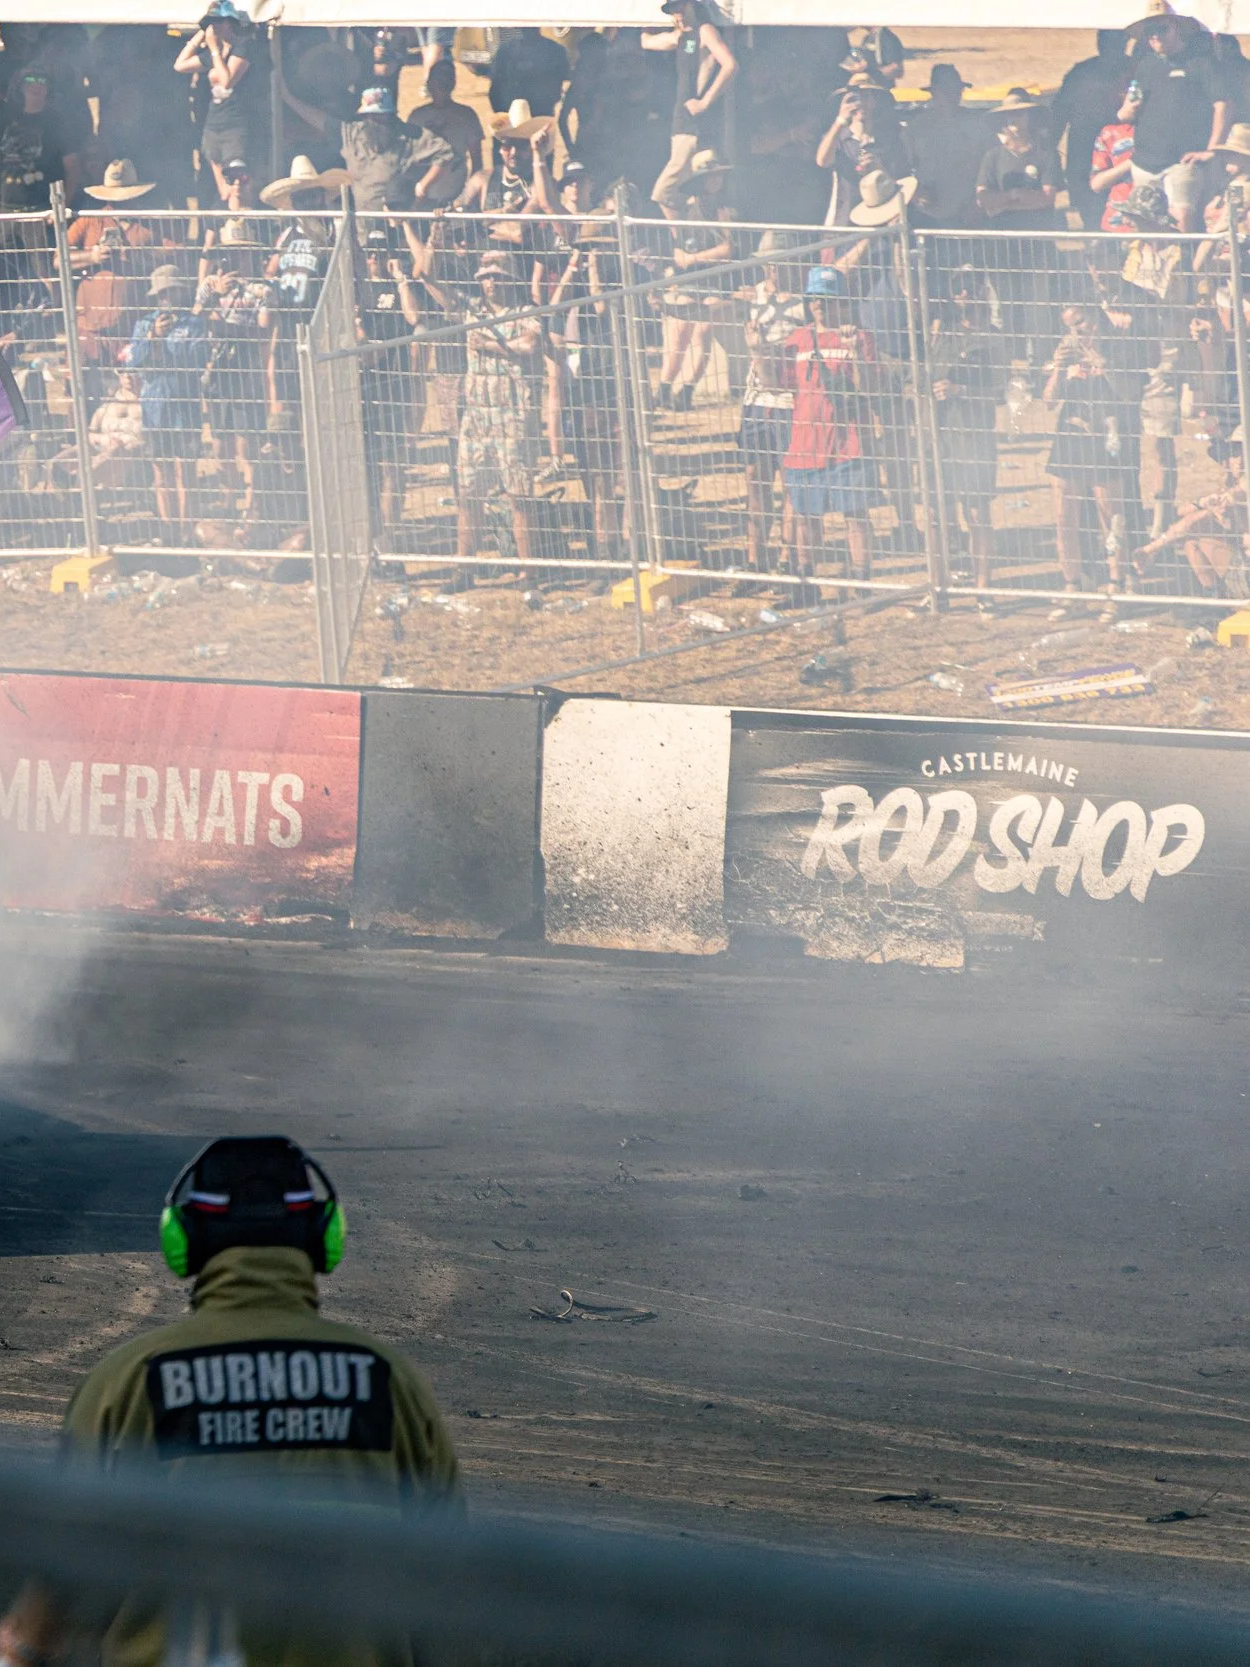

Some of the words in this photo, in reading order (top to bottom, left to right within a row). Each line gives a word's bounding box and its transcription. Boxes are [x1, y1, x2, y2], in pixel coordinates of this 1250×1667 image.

[921, 751, 1079, 788] CASTLEMAINE
[801, 784, 978, 888] ROD
[974, 794, 1206, 904] SHOP
[160, 1349, 376, 1410] BURNOUT
[198, 1408, 259, 1445] FIRE
[265, 1406, 352, 1442] CREW
